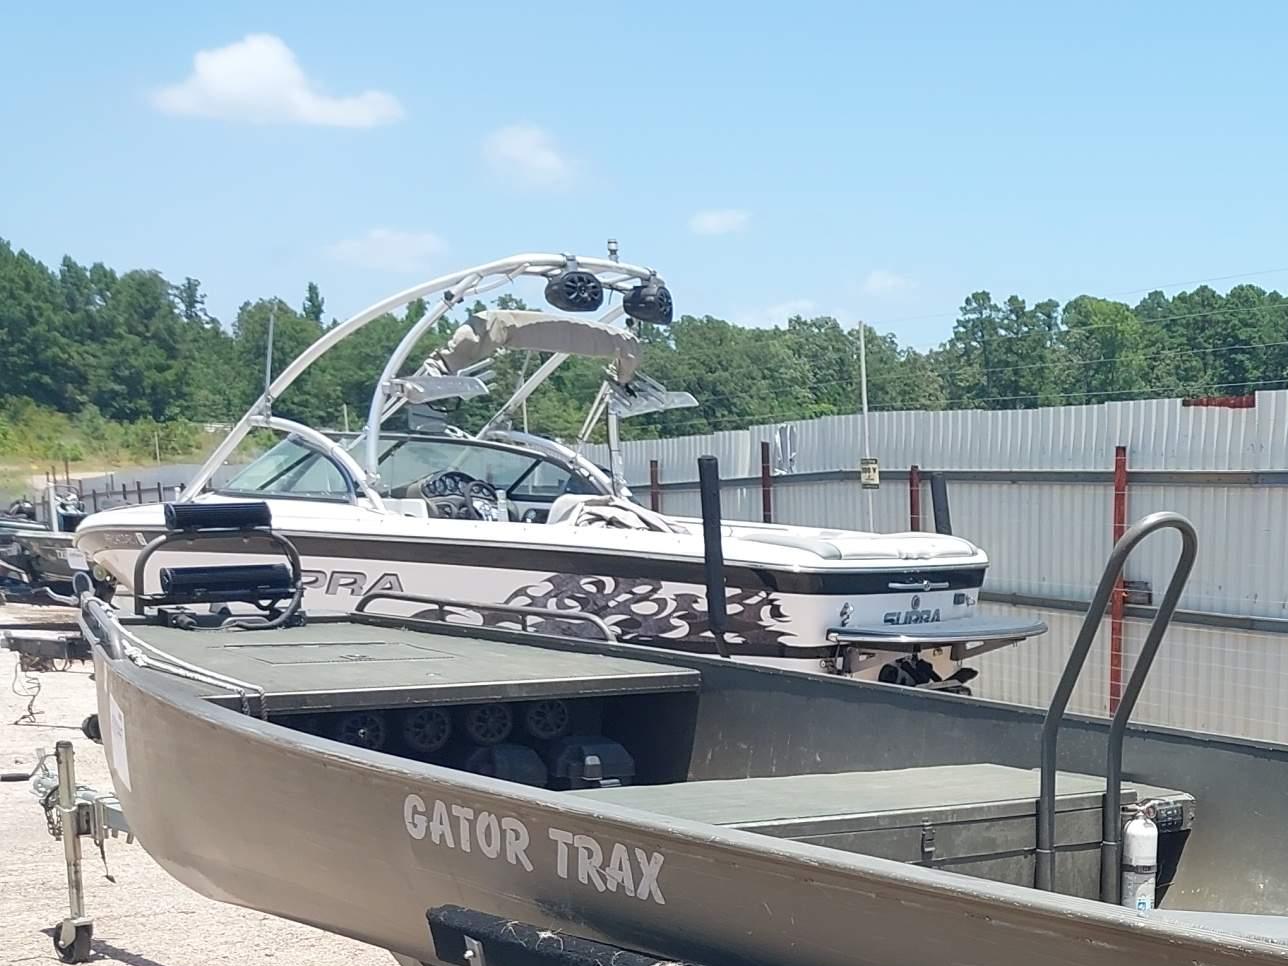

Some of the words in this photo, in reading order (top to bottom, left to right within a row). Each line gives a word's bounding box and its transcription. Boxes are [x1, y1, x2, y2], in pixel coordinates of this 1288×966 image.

[300, 569, 404, 596] PRA
[403, 793, 534, 873] GATOR
[548, 827, 666, 905] TRAX
